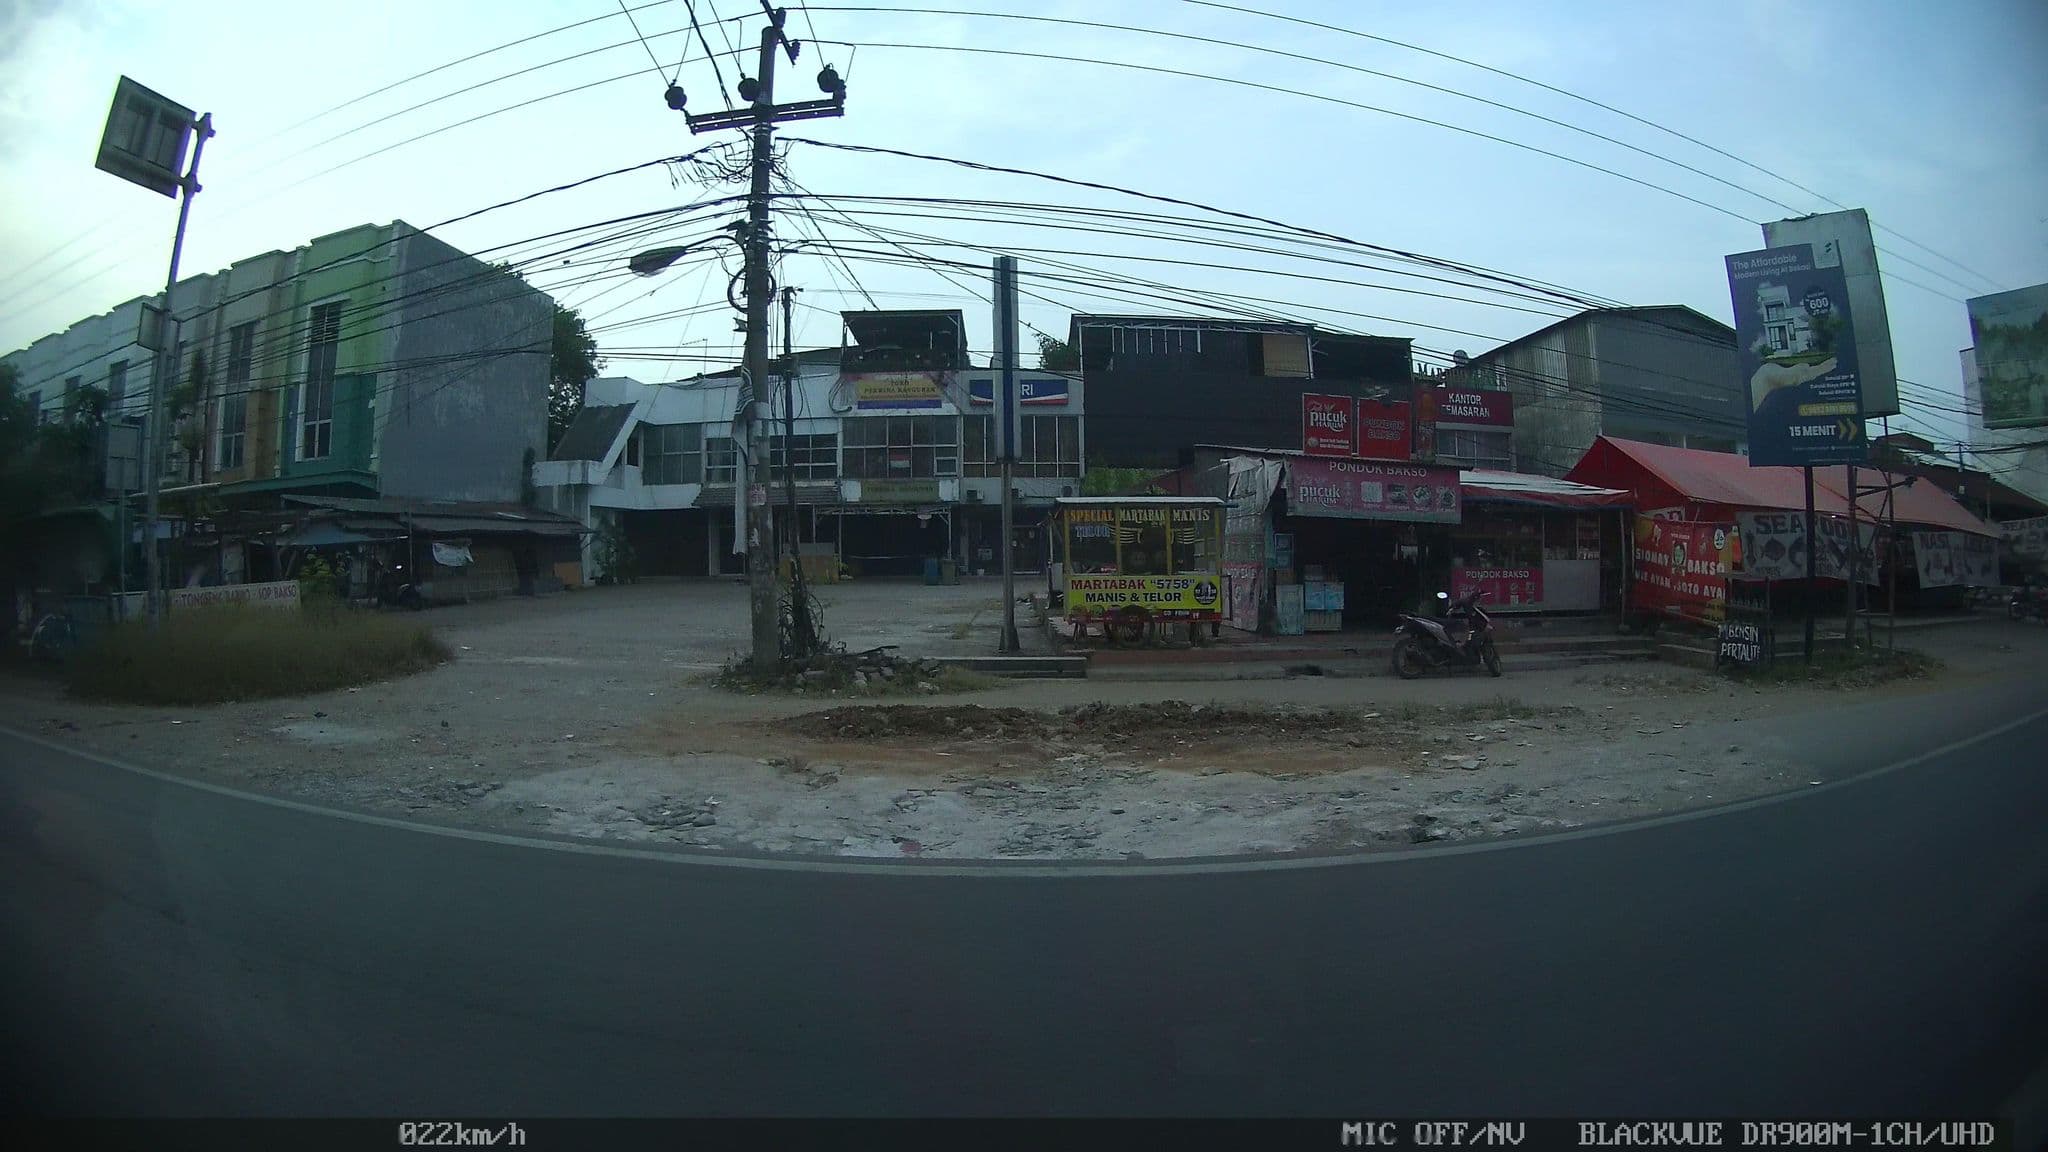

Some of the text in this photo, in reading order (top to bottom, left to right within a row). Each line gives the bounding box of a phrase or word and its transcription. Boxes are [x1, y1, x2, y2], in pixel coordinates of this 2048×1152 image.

[1733, 253, 1798, 270] The Affordable
[1734, 269, 1760, 280] Modern
[1760, 266, 1781, 277] Living
[1809, 297, 1830, 309] 600
[1021, 384, 1034, 395] RI
[1448, 392, 1482, 405] KANTOR
[1441, 404, 1490, 417] EMASARAN
[1310, 409, 1347, 427] pucuk
[1789, 424, 1836, 437] 15 MENIT
[1328, 461, 1428, 478] PONDOK BAKSO
[1299, 484, 1341, 503] pucuk
[1070, 508, 1210, 523] SPECIAL MARTABAK MANIS
[1634, 548, 1725, 576] SIOMAY BAKSO
[1465, 570, 1530, 579] PONDOK BAKSO
[1650, 573, 1671, 589] AYAM
[1071, 579, 1146, 590] MARTABAK
[1086, 592, 1181, 603] MANIS & TELOR
